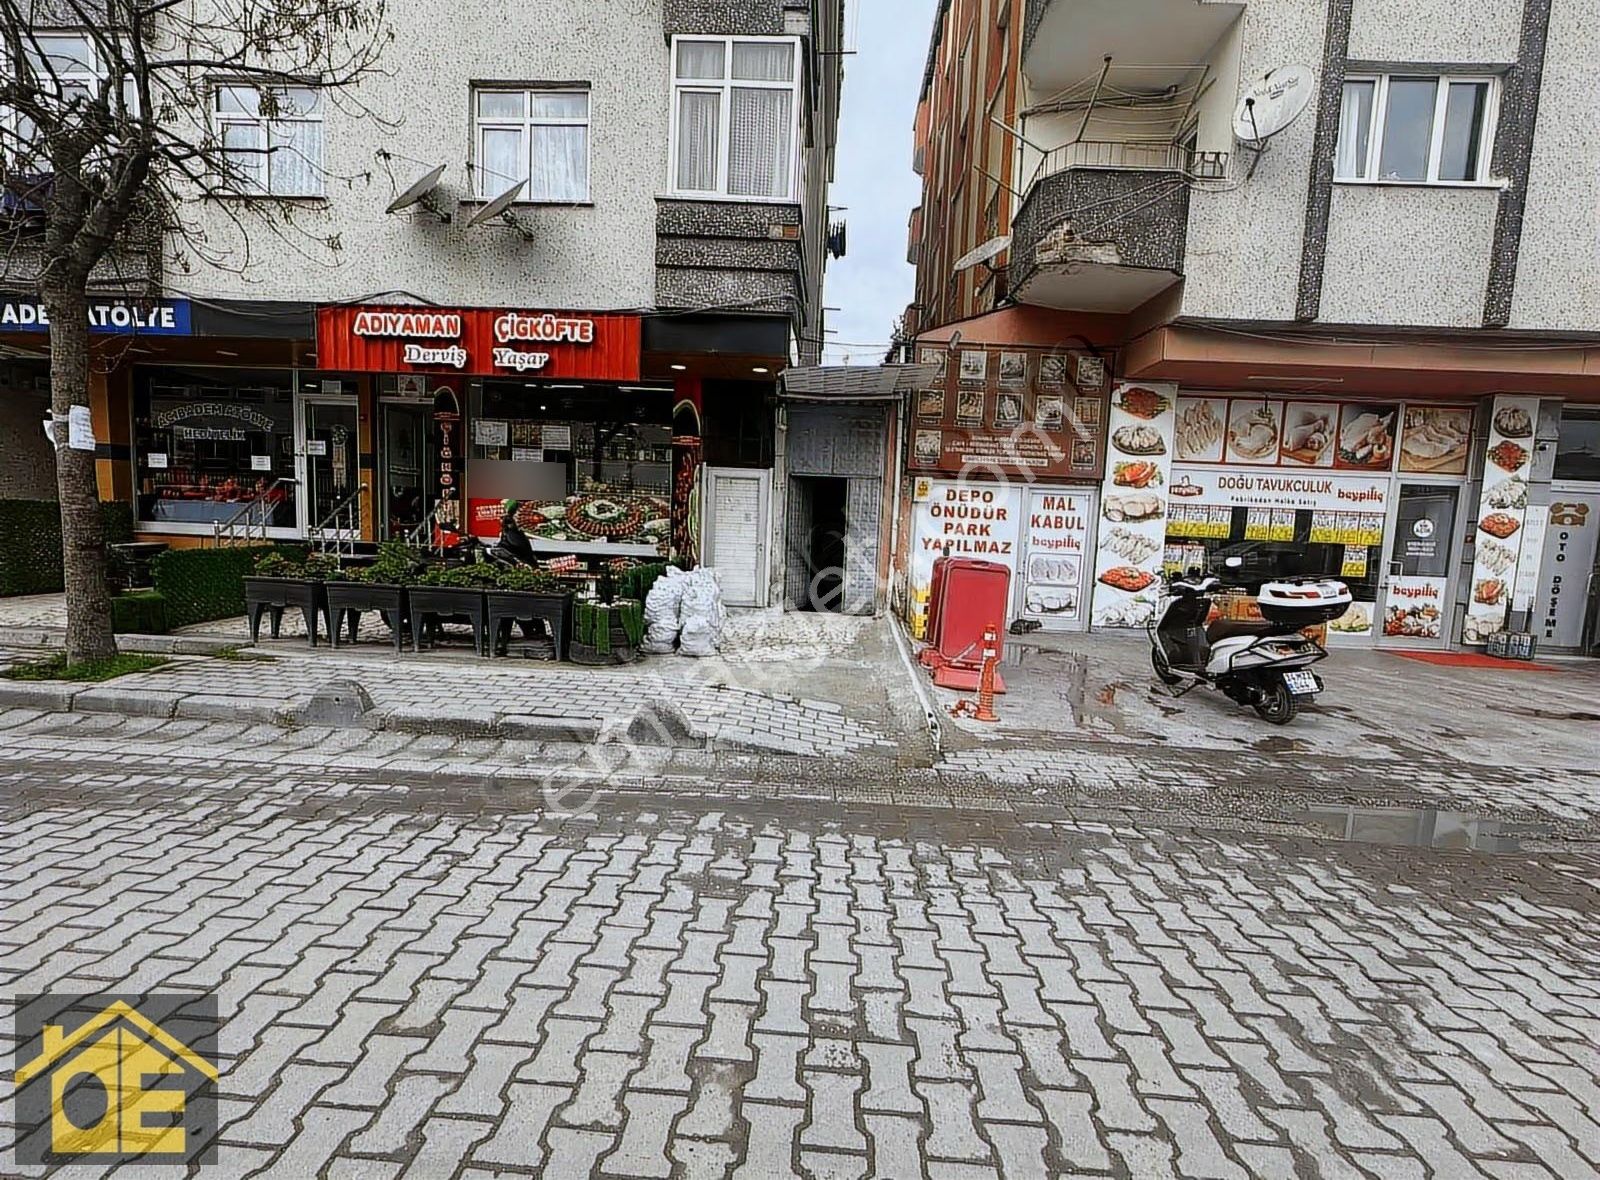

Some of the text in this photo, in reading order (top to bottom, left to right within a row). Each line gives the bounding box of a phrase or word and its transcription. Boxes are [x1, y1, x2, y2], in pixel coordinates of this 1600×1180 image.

[354, 312, 461, 338] ADIYAMAN
[404, 345, 549, 370] Derviş Yaşar
[1218, 474, 1332, 494] DOĞU TAVUKCULUK
[945, 488, 994, 504] DEPO
[1042, 496, 1076, 512] MAL
[930, 502, 1008, 521] ÖNÜDÜR
[943, 522, 992, 537] PARK
[1031, 513, 1085, 531] KABUL
[921, 537, 1012, 555] YAPILMAZ
[1556, 531, 1569, 562] OTO
[1545, 575, 1563, 638] DÖŞEME
